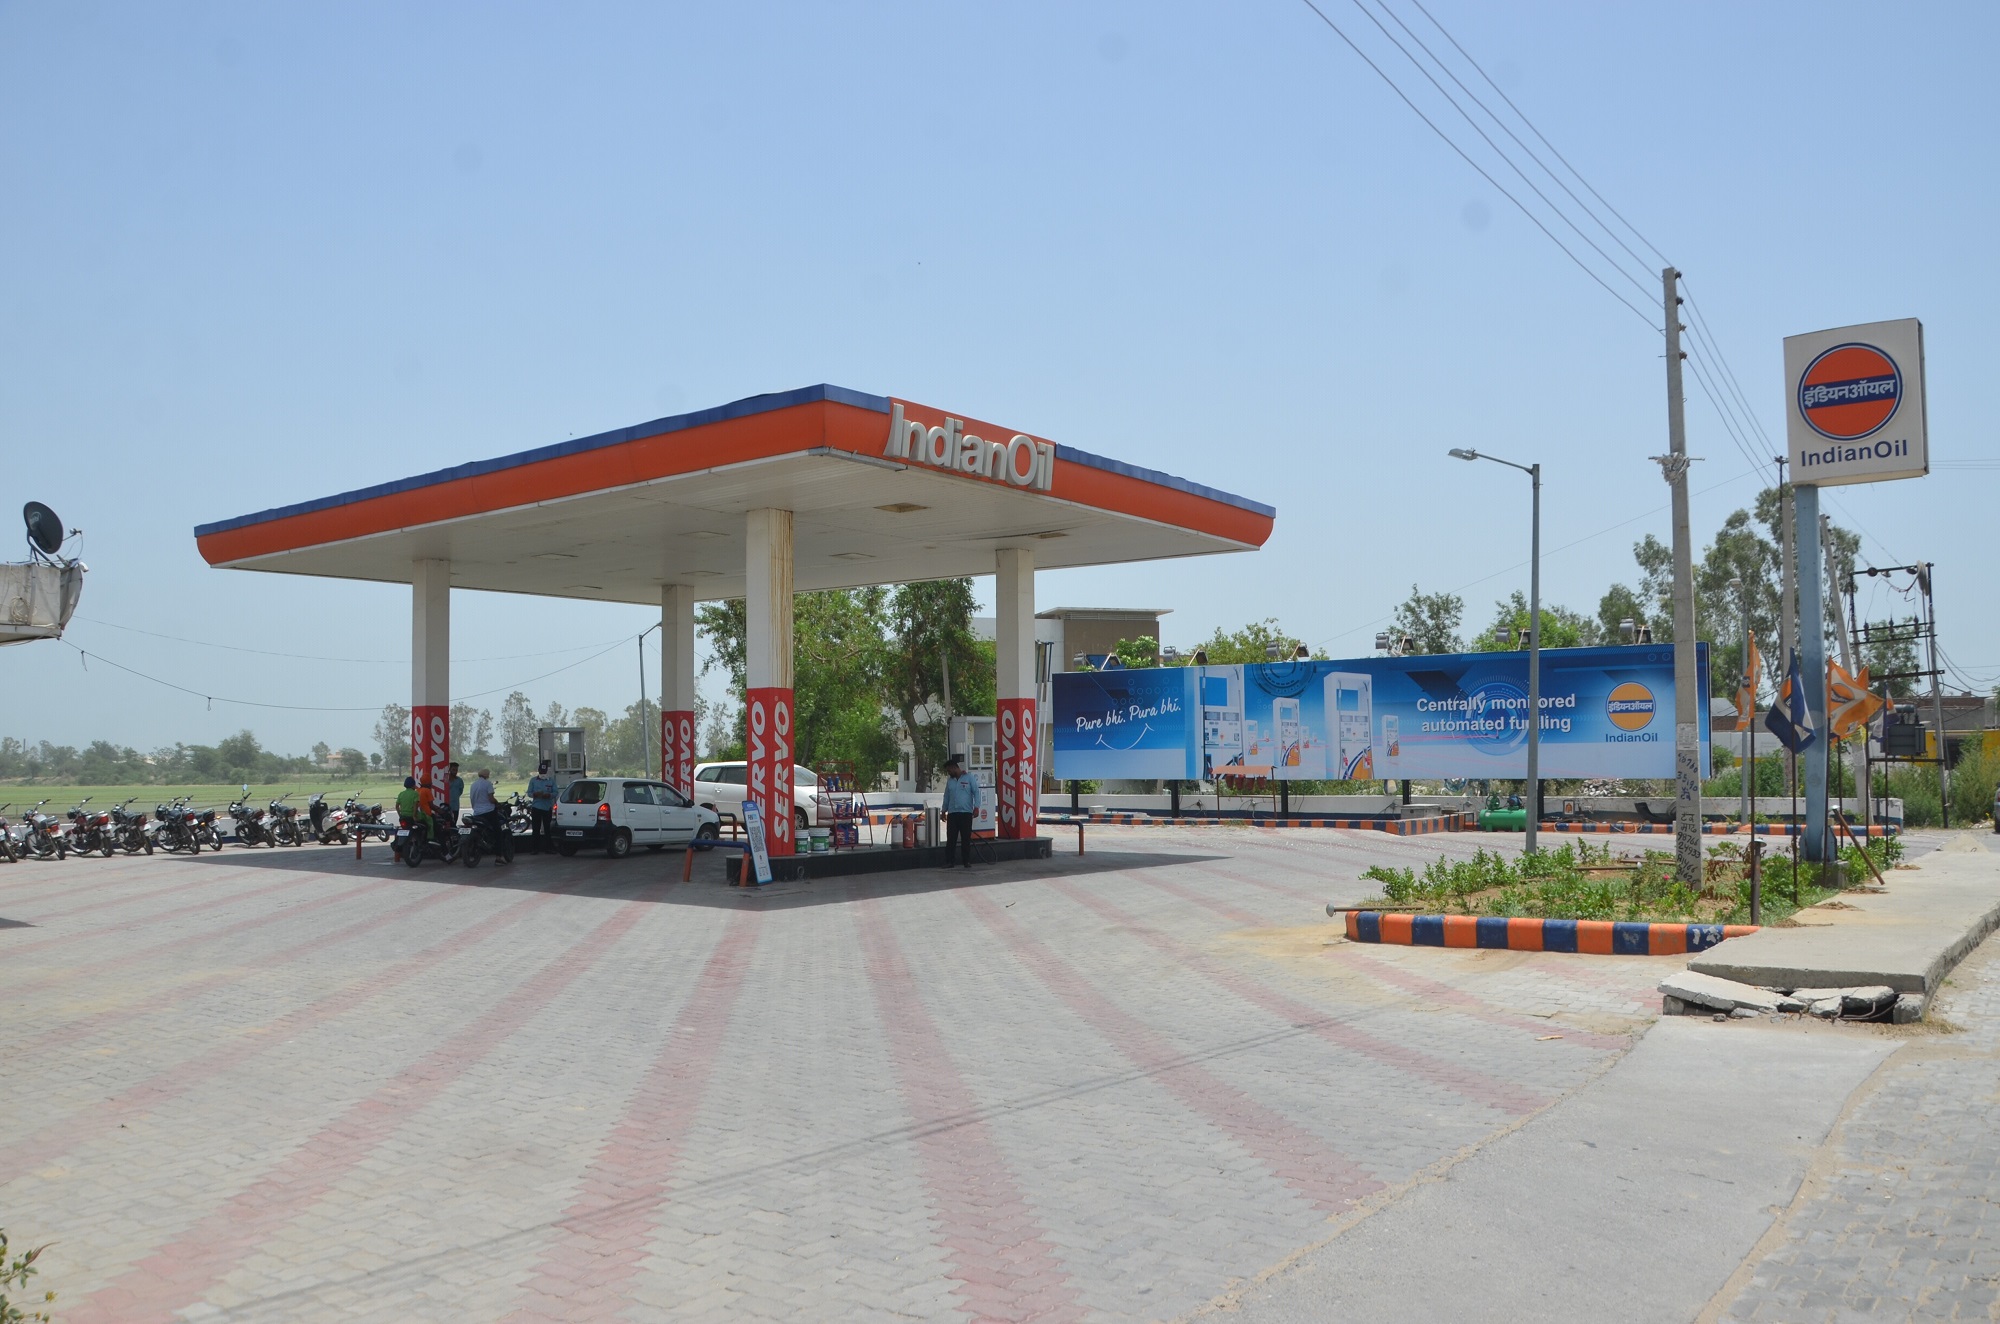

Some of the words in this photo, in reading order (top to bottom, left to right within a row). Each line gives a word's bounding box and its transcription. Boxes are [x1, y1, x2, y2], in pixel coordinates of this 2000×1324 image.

[883, 403, 1055, 491] IndianOil
[1801, 439, 1908, 467] IndianOil
[1076, 716, 1103, 733] Pure
[1129, 704, 1158, 721] Pura
[1416, 697, 1487, 714] Centrally
[1491, 693, 1576, 710] moniored
[1421, 716, 1505, 732] automated
[1509, 715, 1571, 733] fuling
[1605, 732, 1658, 743] IndianOil
[430, 716, 445, 808] ERVO
[664, 720, 675, 785] RVO
[680, 719, 691, 801] ERVO
[751, 701, 766, 840] ERVO
[774, 701, 790, 843] SERVO
[1001, 709, 1016, 828] SERVO
[1022, 708, 1034, 827] SERVO
